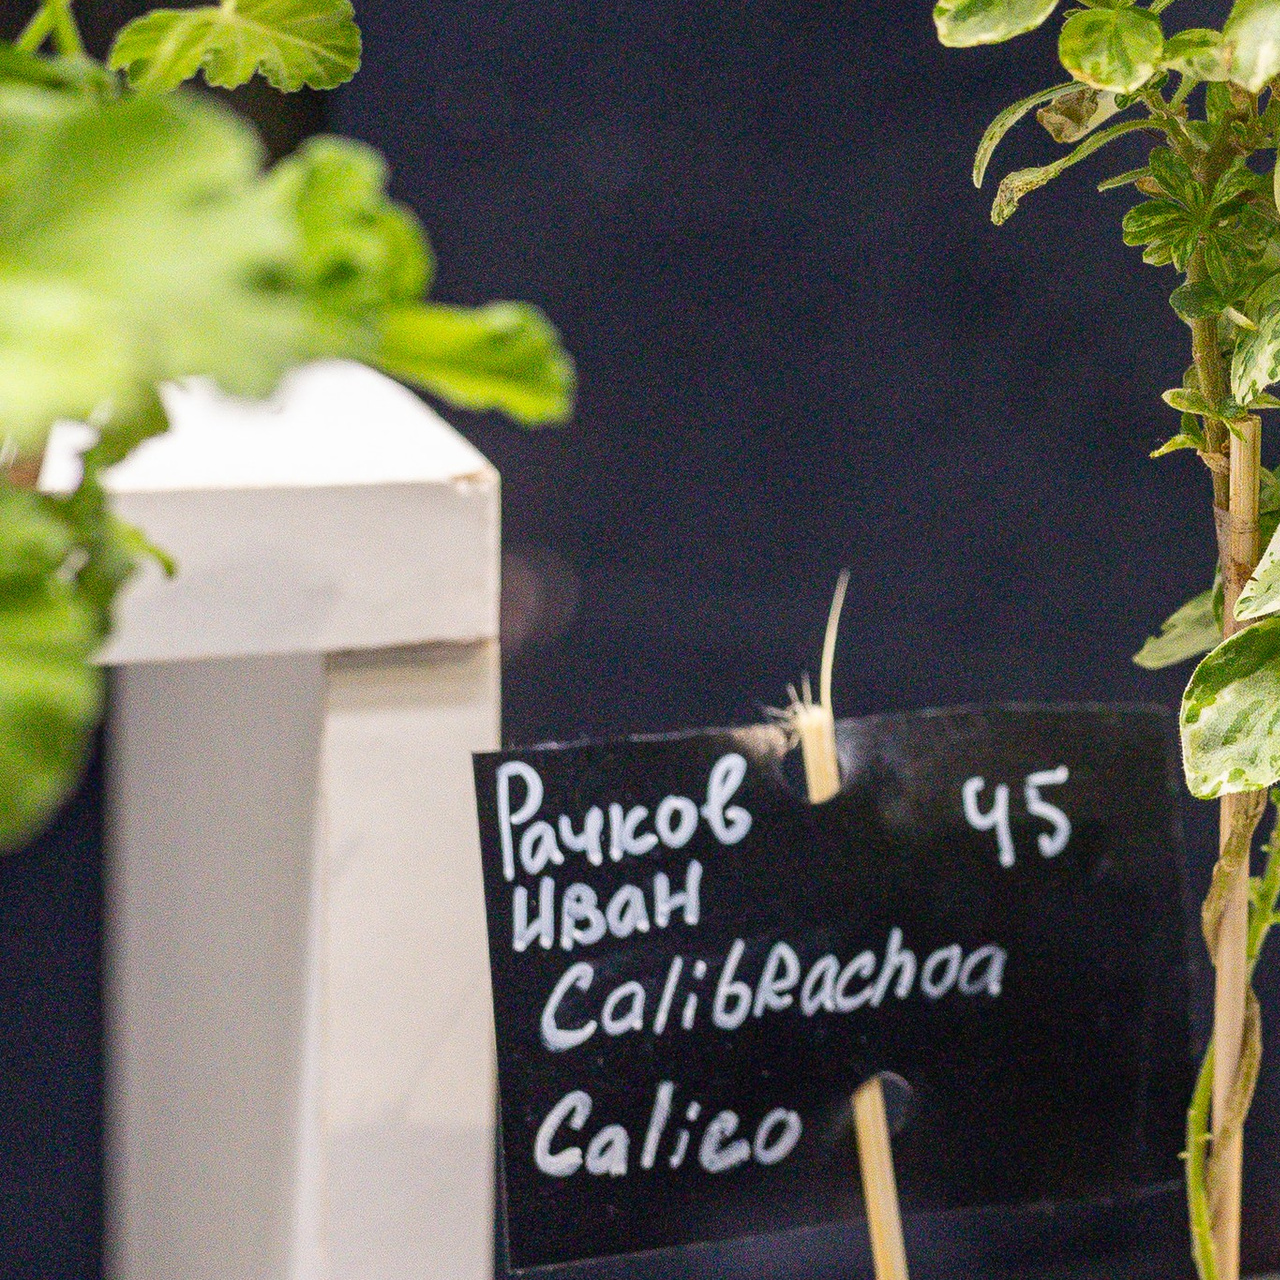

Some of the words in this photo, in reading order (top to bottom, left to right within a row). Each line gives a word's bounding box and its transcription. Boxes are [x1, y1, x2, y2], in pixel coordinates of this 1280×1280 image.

[497, 754, 754, 882] Рачков
[511, 861, 704, 952] Иван
[533, 1081, 802, 1178] Calico
